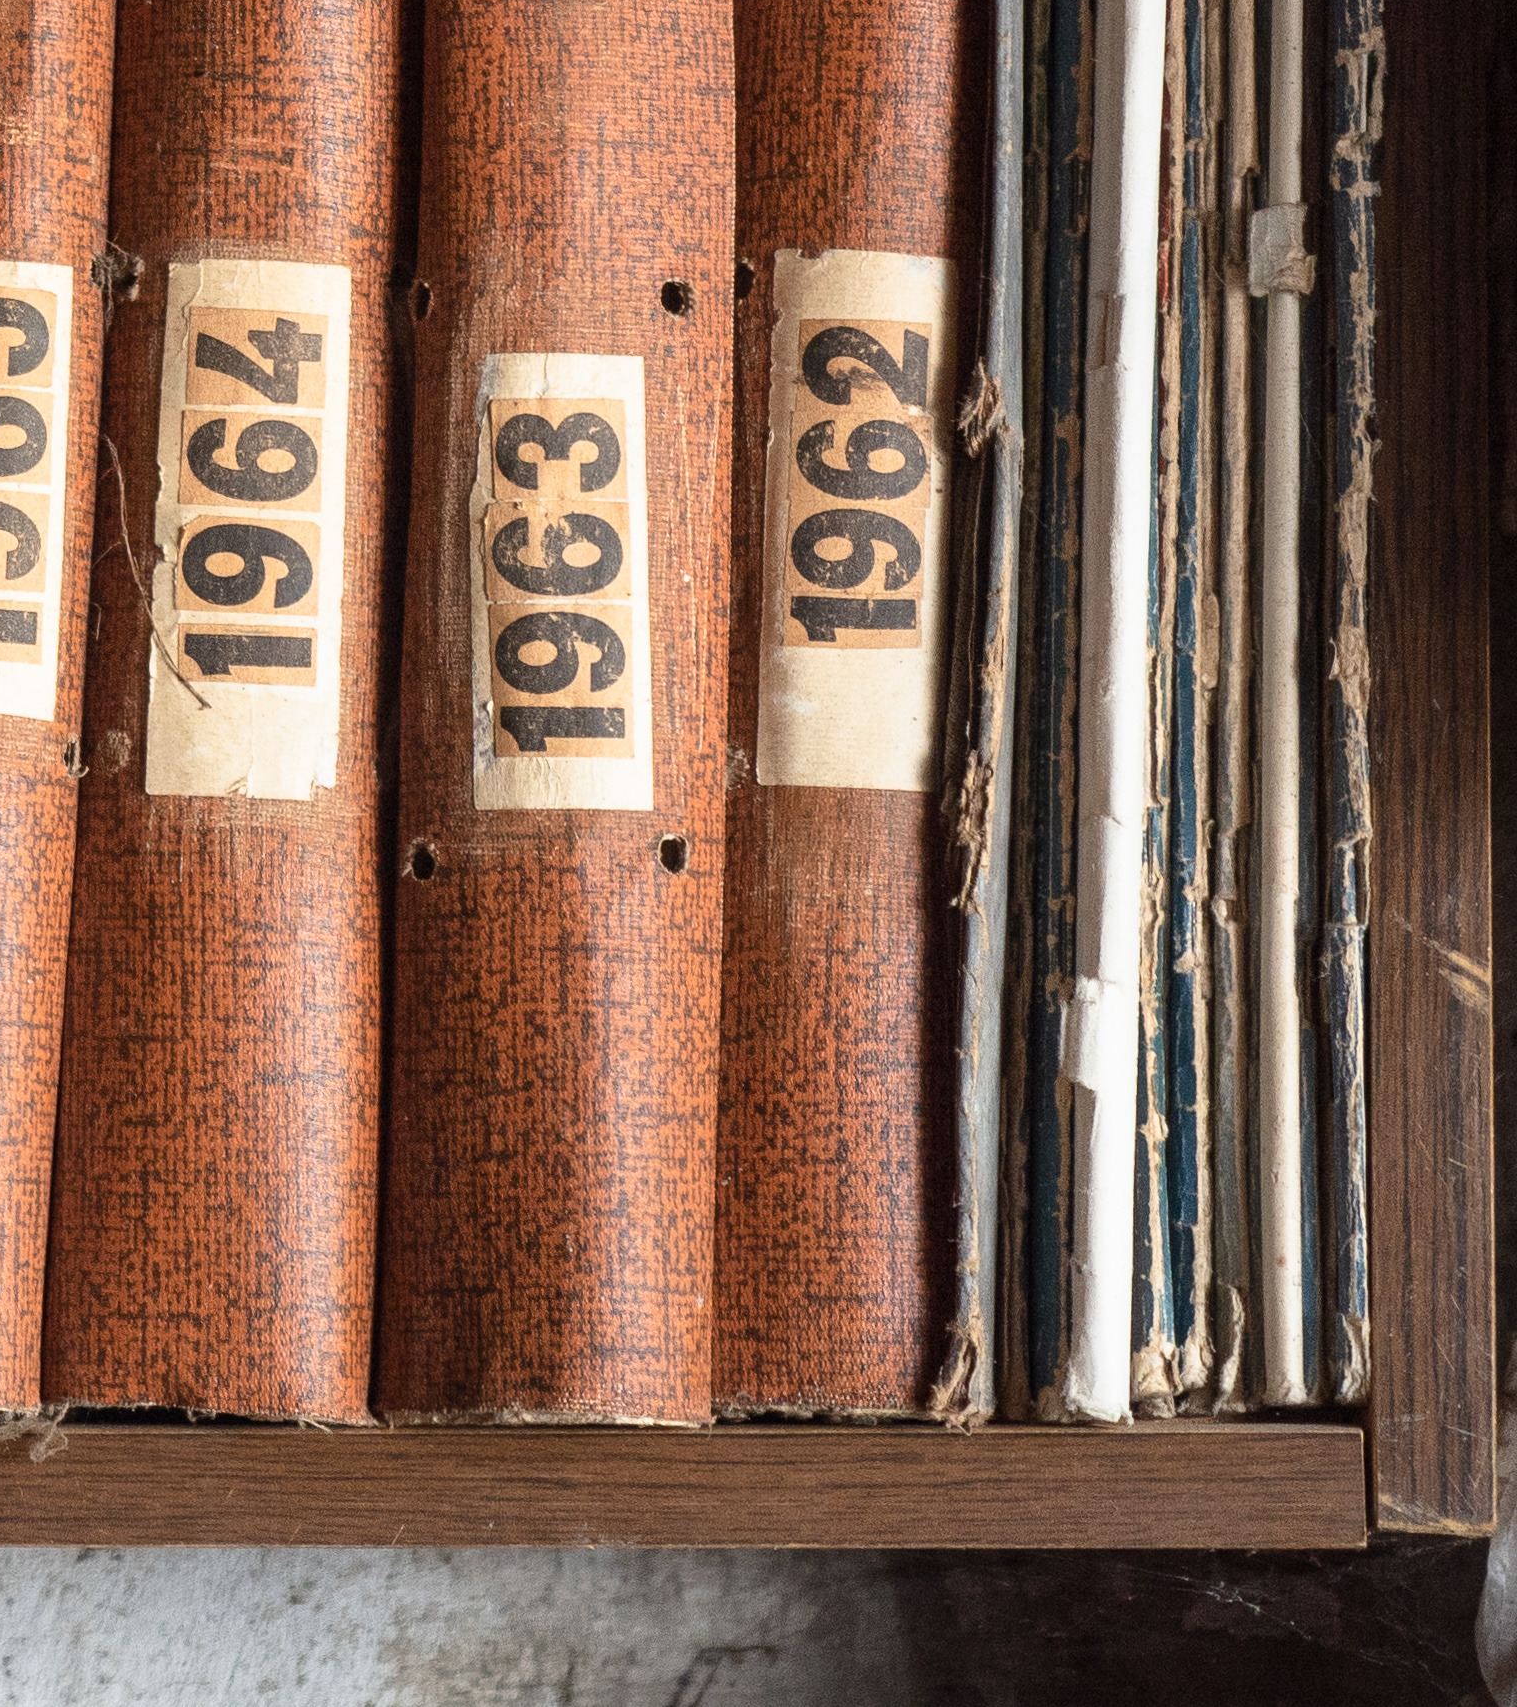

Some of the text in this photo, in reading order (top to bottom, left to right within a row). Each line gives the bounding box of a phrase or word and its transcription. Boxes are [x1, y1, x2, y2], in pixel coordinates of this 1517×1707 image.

[182, 317, 321, 675] 1964
[494, 412, 625, 751] 1963
[790, 325, 928, 643] 1962
